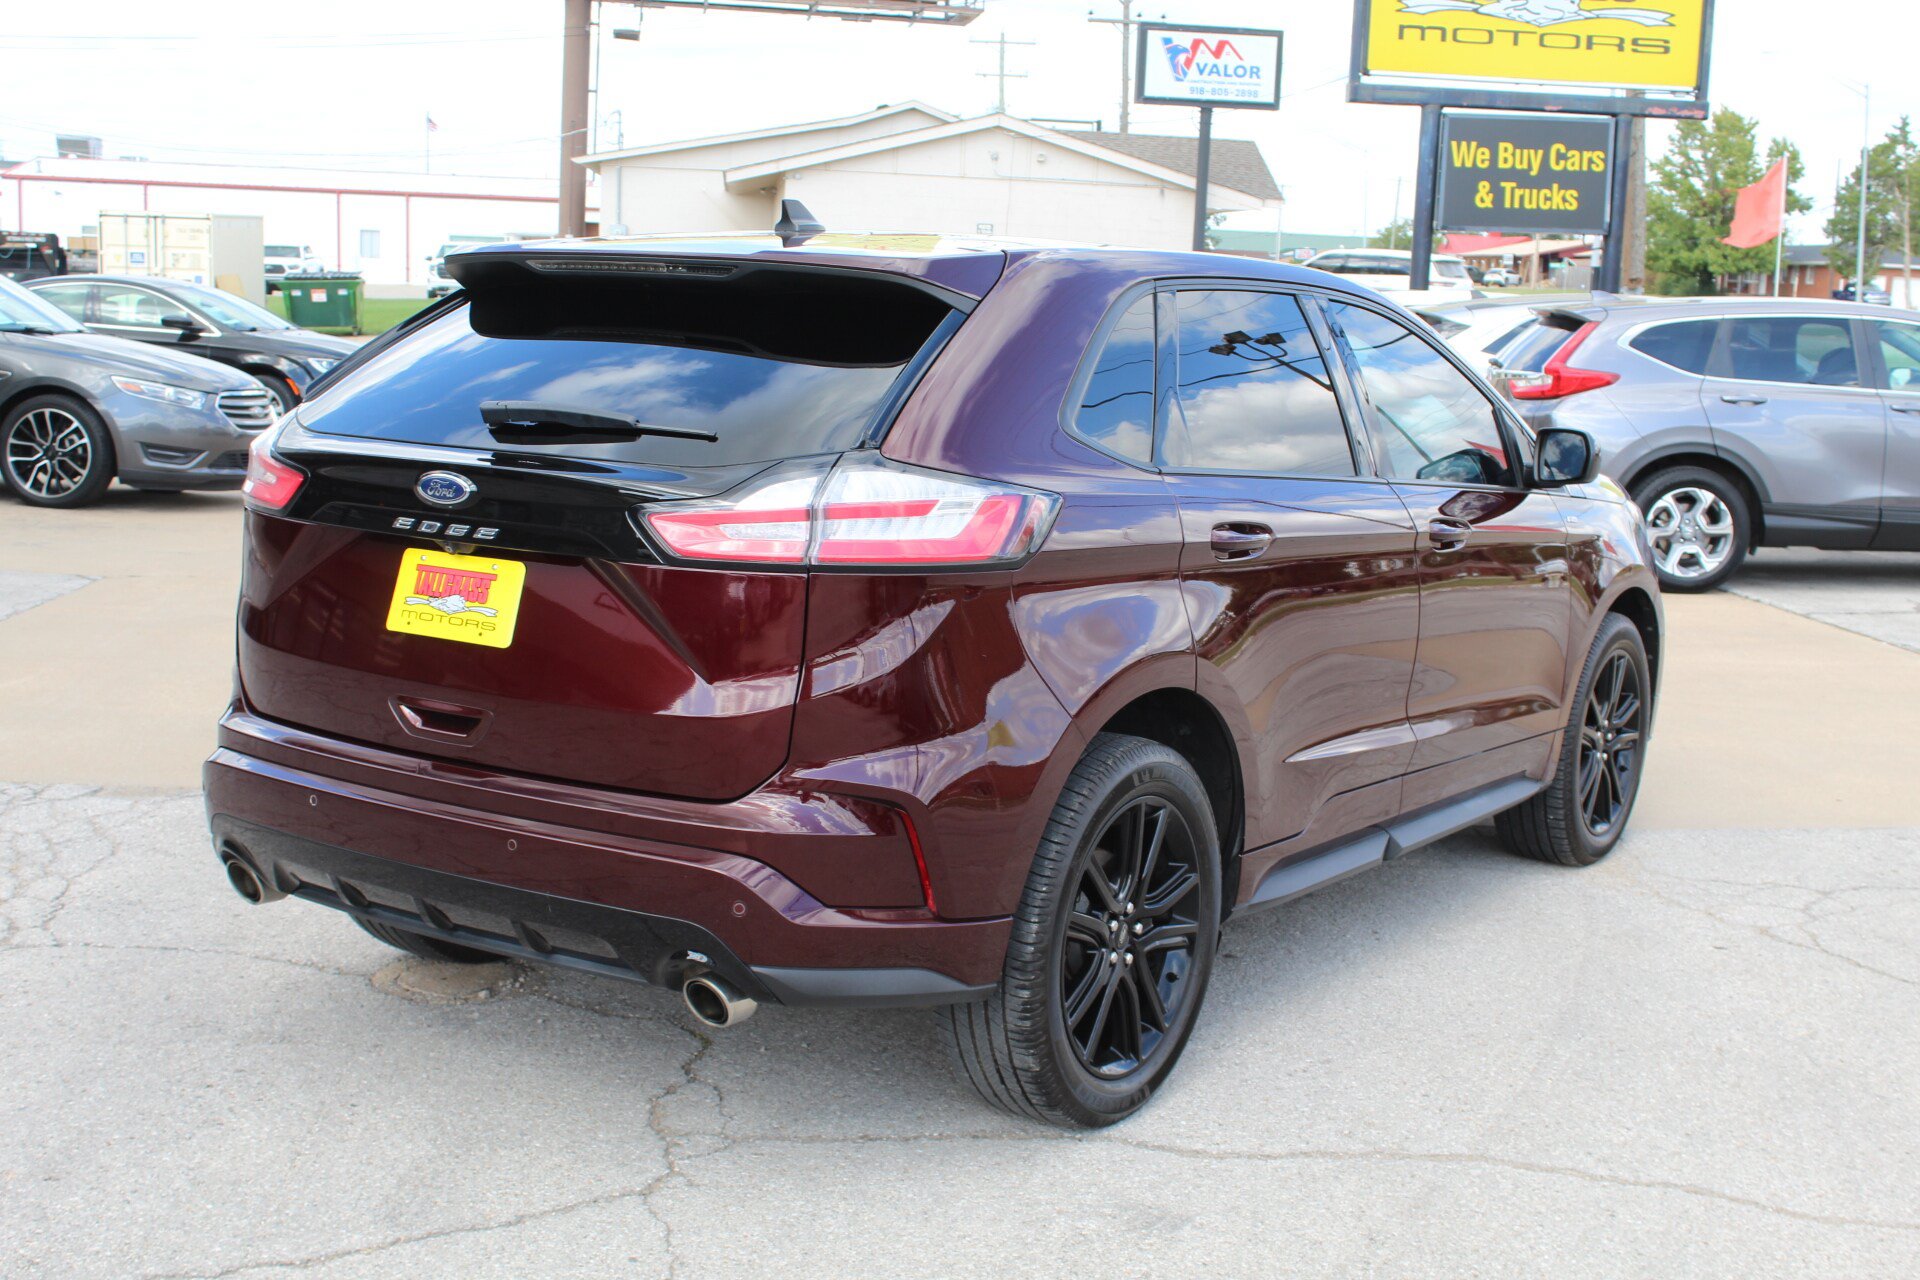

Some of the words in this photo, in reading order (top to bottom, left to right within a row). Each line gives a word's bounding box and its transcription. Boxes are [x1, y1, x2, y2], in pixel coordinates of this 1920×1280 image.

[1398, 24, 1671, 54] MOTORS
[1195, 62, 1261, 79] VALOR
[1189, 86, 1259, 98] 918-805-2898
[1451, 140, 1491, 169] We
[1497, 141, 1544, 176] Buy
[1550, 143, 1606, 172] Cars
[1474, 180, 1494, 208] &
[1500, 181, 1579, 211] Trucks
[426, 479, 456, 498] Ford
[392, 517, 500, 540] EDGE
[401, 609, 496, 631] MOTORS
